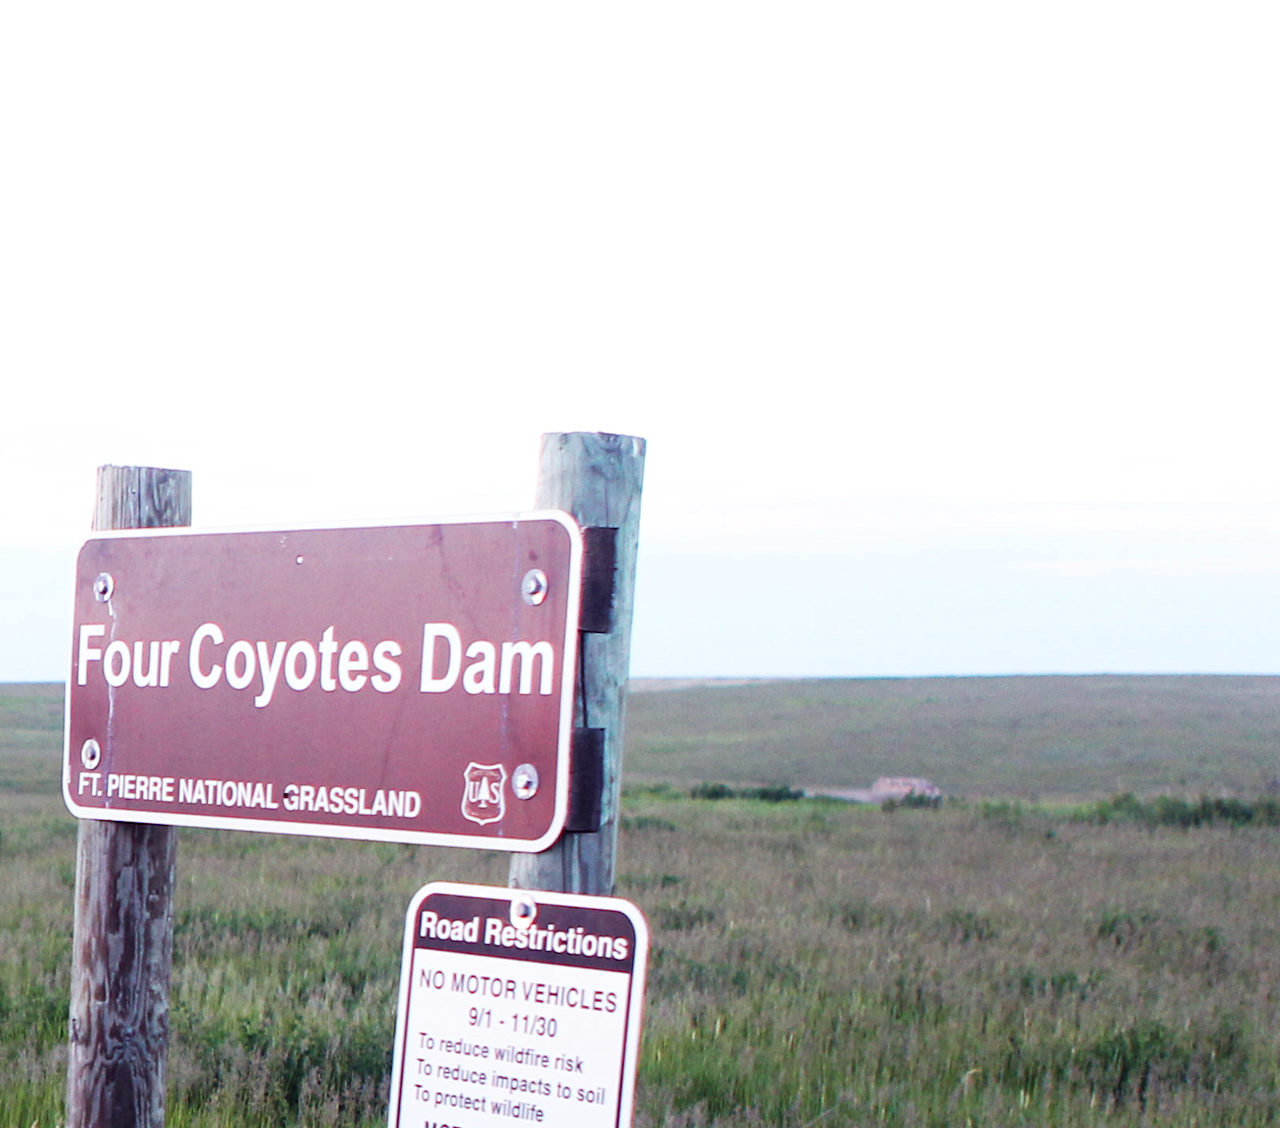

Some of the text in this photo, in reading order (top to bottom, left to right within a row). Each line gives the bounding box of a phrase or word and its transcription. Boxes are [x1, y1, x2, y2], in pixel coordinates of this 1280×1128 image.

[77, 621, 554, 707] Four Coyotes Dam
[78, 772, 421, 818] FT. PIERRE NATIONAL GRASSLAND
[420, 911, 629, 961] Road Restrictions
[419, 969, 617, 1013] NO MOTOR VEHICLES
[469, 1007, 492, 1028] 9/1
[512, 1013, 557, 1038] 11/30
[419, 1032, 583, 1074] To reduce wildfire risk
[414, 1084, 545, 1123] To protect wildlife
[416, 1058, 606, 1105] To reduce impacts to soil
